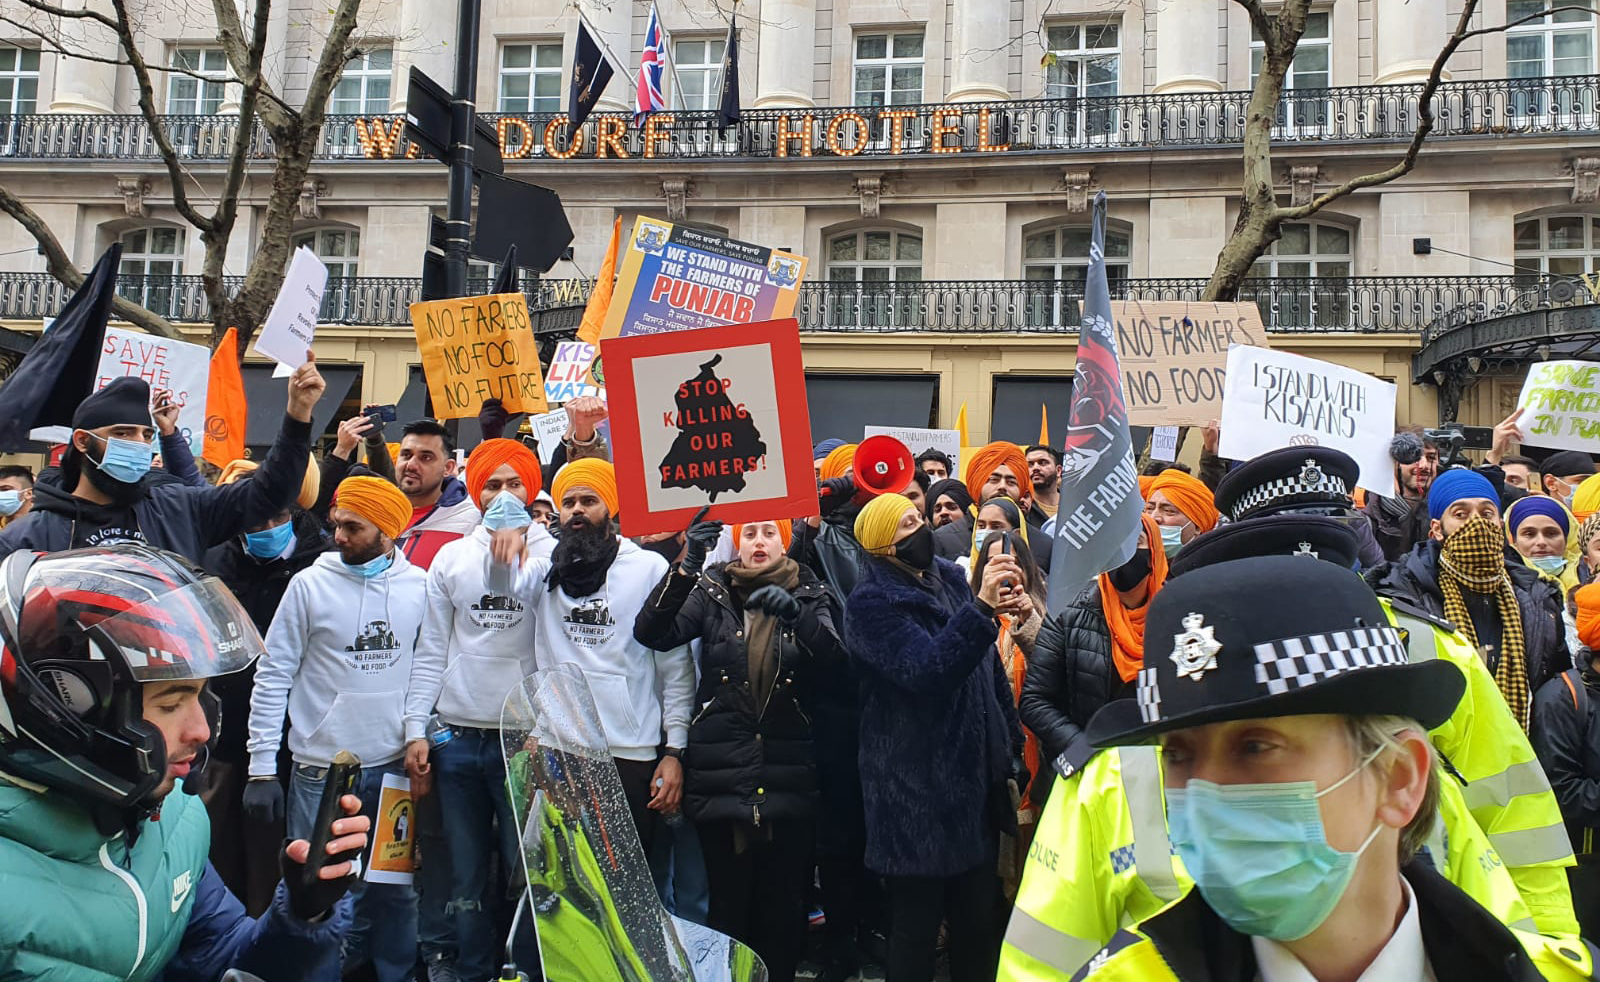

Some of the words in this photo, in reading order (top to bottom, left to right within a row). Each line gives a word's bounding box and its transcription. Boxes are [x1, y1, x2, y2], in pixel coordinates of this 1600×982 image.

[355, 116, 675, 159] WDORF
[776, 108, 1010, 158] HOTEL
[660, 260, 683, 277] THE
[687, 267, 743, 293] FARMERS
[744, 282, 761, 297] OF
[666, 245, 686, 263] WE
[687, 252, 727, 272] STAND
[729, 261, 763, 282] WITH
[649, 273, 756, 323] PUNJAB
[426, 308, 454, 339] NO
[1117, 317, 1153, 358] NO
[1160, 315, 1256, 357] FARMERS
[104, 334, 168, 366] SAVE
[443, 345, 470, 376] NO
[120, 360, 171, 385] THE
[1533, 364, 1600, 389] SAVE
[98, 376, 189, 407] FERS
[444, 381, 470, 410] NO
[678, 378, 732, 399] STOP
[1126, 370, 1162, 407] NO
[663, 403, 748, 428] KILLING
[1264, 389, 1356, 439] KISAANS
[1530, 414, 1563, 437] IN
[547, 425, 562, 435] ARE
[690, 432, 733, 451] OUR
[661, 454, 767, 483] FARMERS!
[1058, 503, 1104, 550] THE
[1028, 840, 1060, 873] OLICE
[173, 869, 192, 898] NIKE
